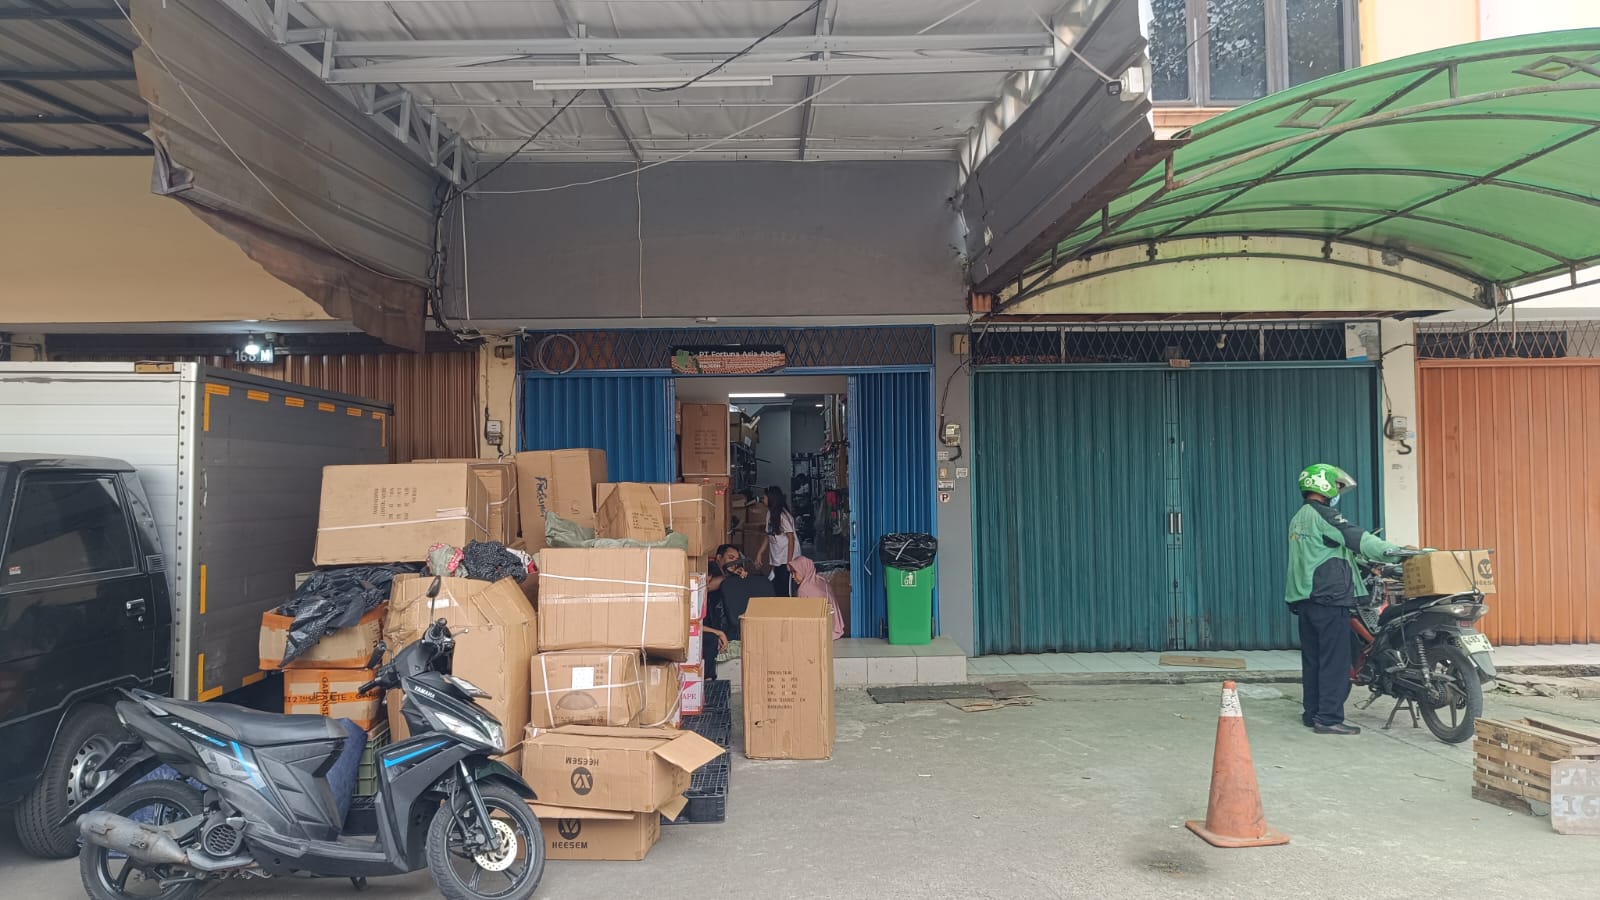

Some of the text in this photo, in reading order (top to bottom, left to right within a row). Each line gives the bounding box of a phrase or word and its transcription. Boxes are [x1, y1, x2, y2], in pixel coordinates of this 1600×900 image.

[699, 350, 782, 358] PT Fortuna Asia Abadi
[565, 756, 600, 767] HEESEM
[551, 841, 588, 850] HEESEM
